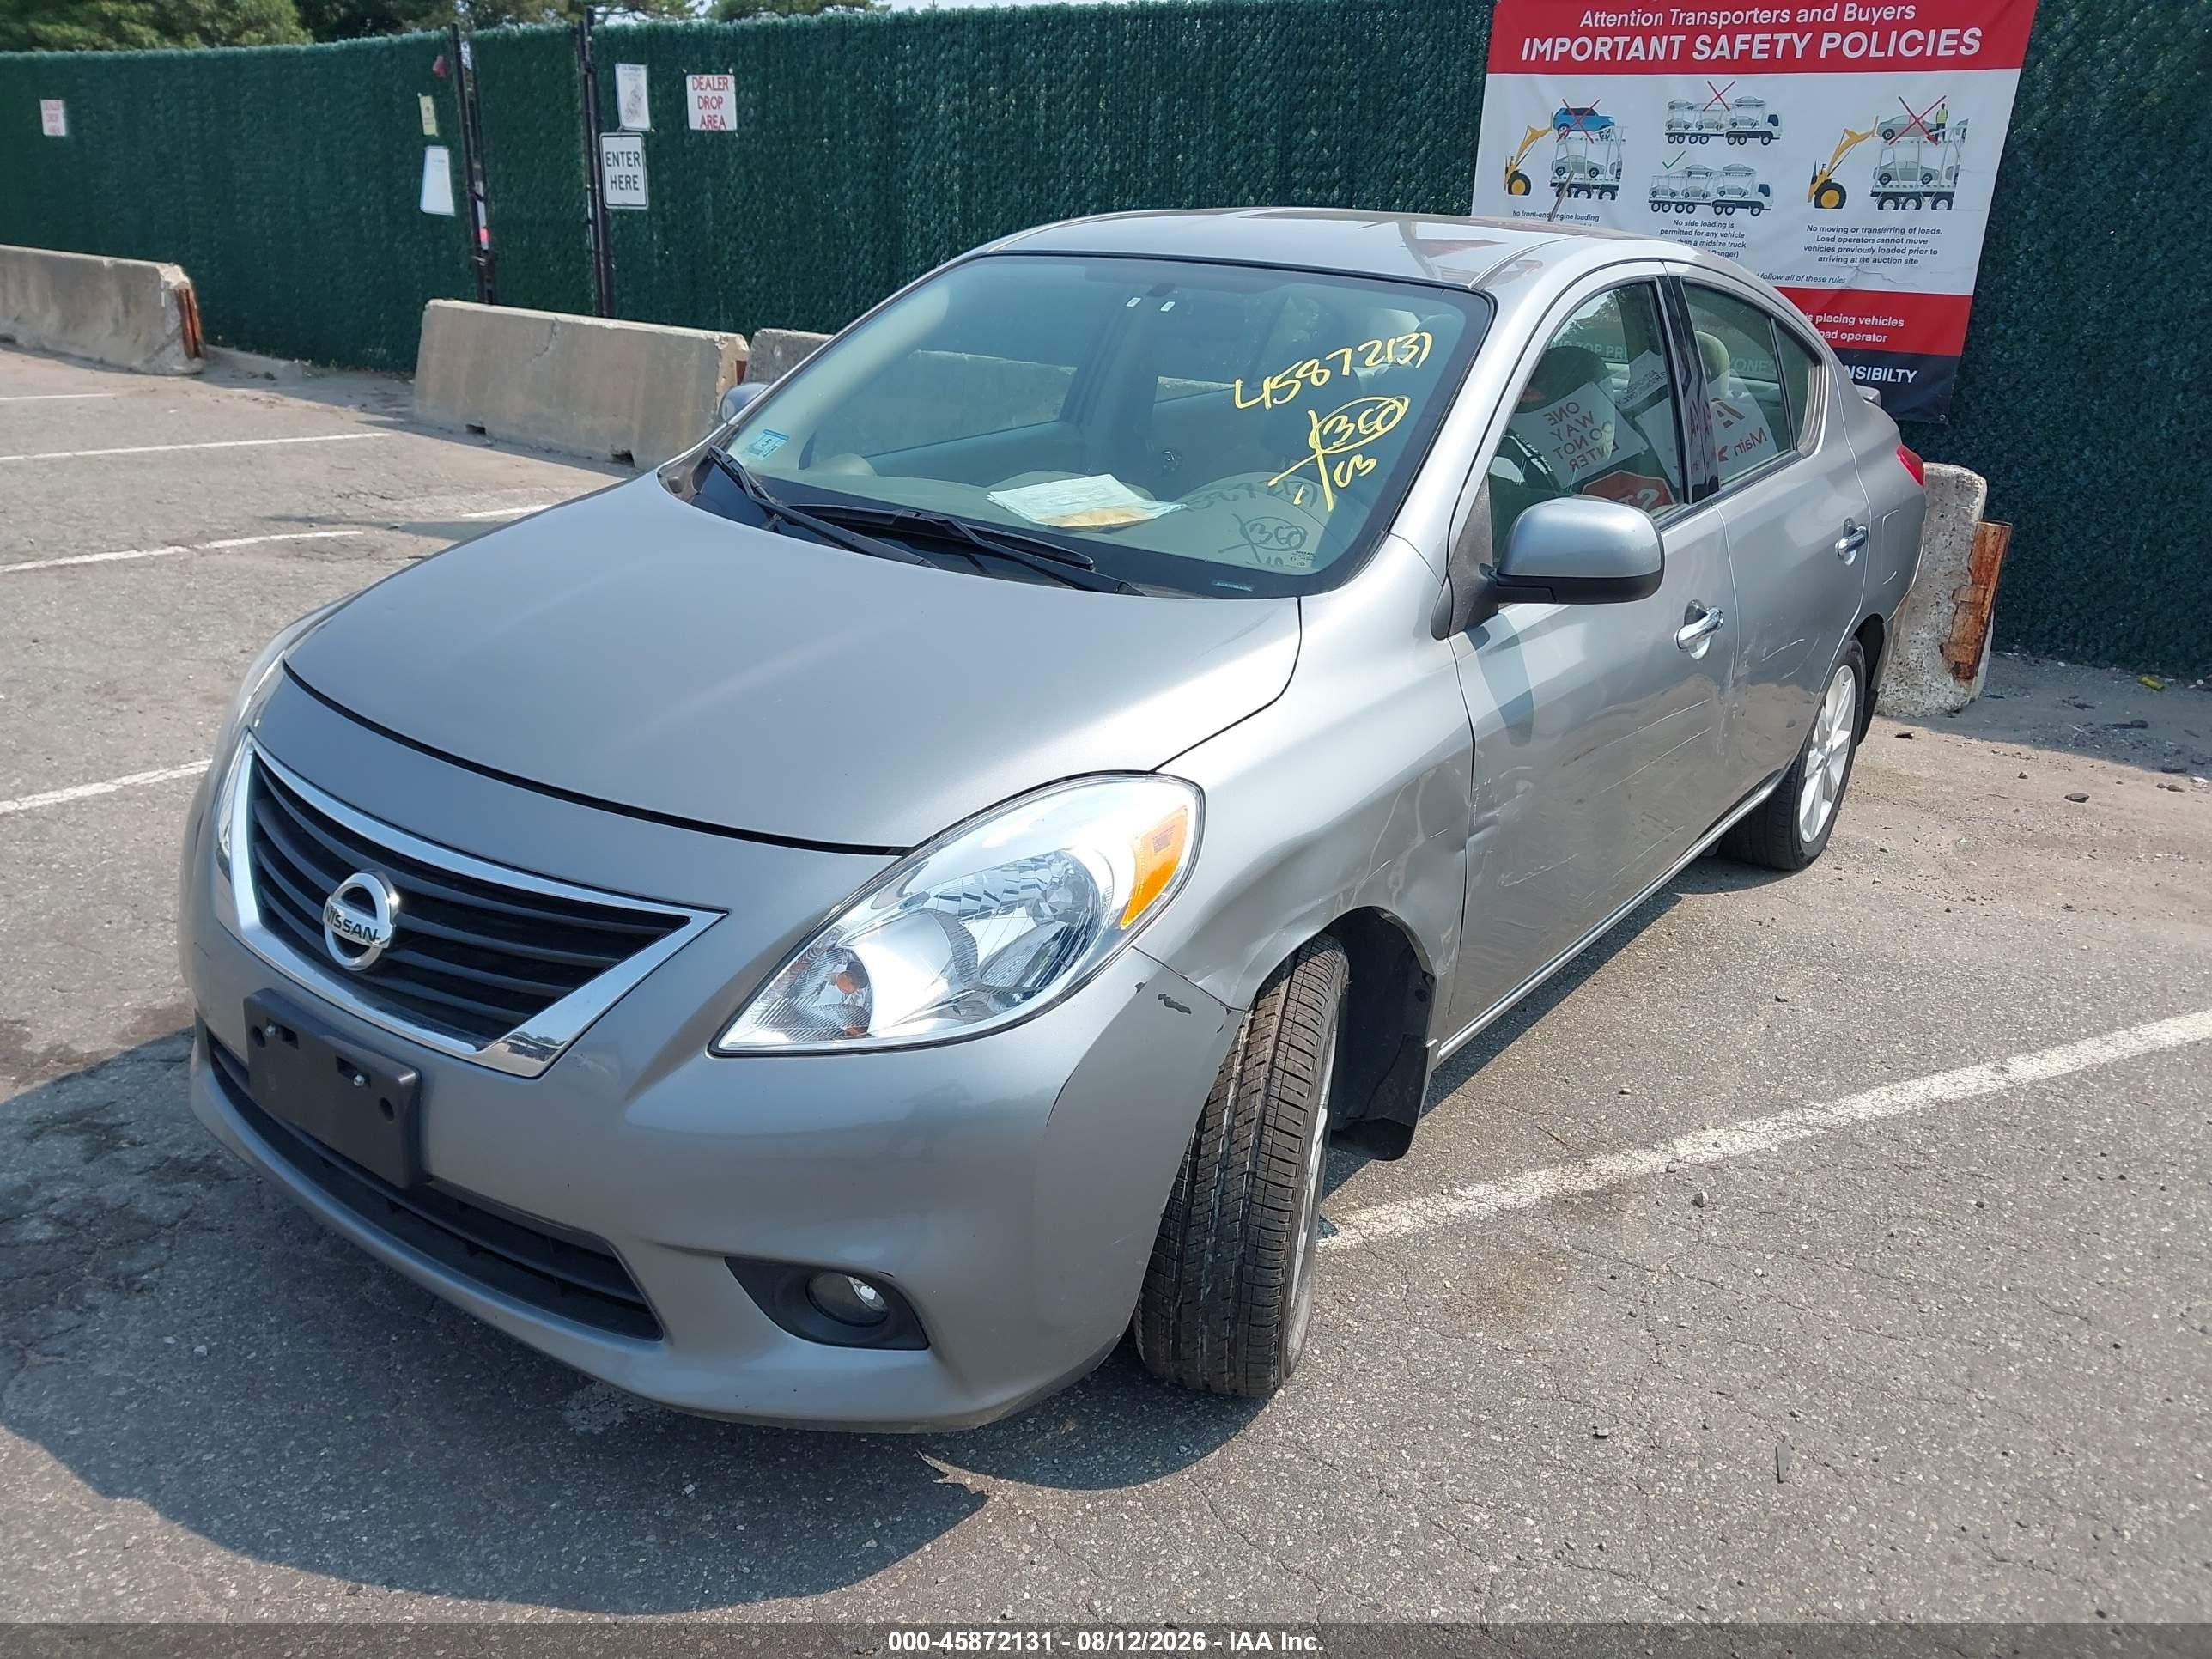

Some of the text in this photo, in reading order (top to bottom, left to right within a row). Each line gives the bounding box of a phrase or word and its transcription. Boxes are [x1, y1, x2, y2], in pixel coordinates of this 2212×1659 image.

[1580, 3, 1917, 30] Attention Transporters and Buyers
[1521, 27, 1983, 62] IMPORTANT SAFETY POLICIES
[692, 76, 729, 91] DEALER
[697, 96, 724, 110] DROP
[700, 115, 727, 130] AREA
[605, 151, 641, 167] ENTER
[610, 174, 640, 191] HERE
[1553, 212, 1574, 222] ngine
[1574, 213, 1600, 223] loading
[1700, 220, 1727, 229] loading
[1820, 226, 1849, 234] moving
[1917, 227, 1943, 235] loads.
[1728, 240, 1747, 249] truck
[1837, 236, 1875, 245] operators
[1803, 245, 1836, 253] vehicles
[1837, 246, 1876, 254] previously
[1877, 246, 1906, 255] loaded
[1908, 247, 1928, 257] prior
[1818, 256, 1848, 264] arriving
[1872, 257, 1903, 265] auction
[1784, 273, 1795, 282] all
[1805, 275, 1827, 283] these
[1828, 276, 1846, 284] rules
[1815, 313, 1856, 325] placing
[1858, 314, 1905, 327] vehicles
[1820, 330, 1888, 343] oad operator
[1844, 364, 1918, 384] NSIBILTY
[326, 906, 378, 943] NISSAN
